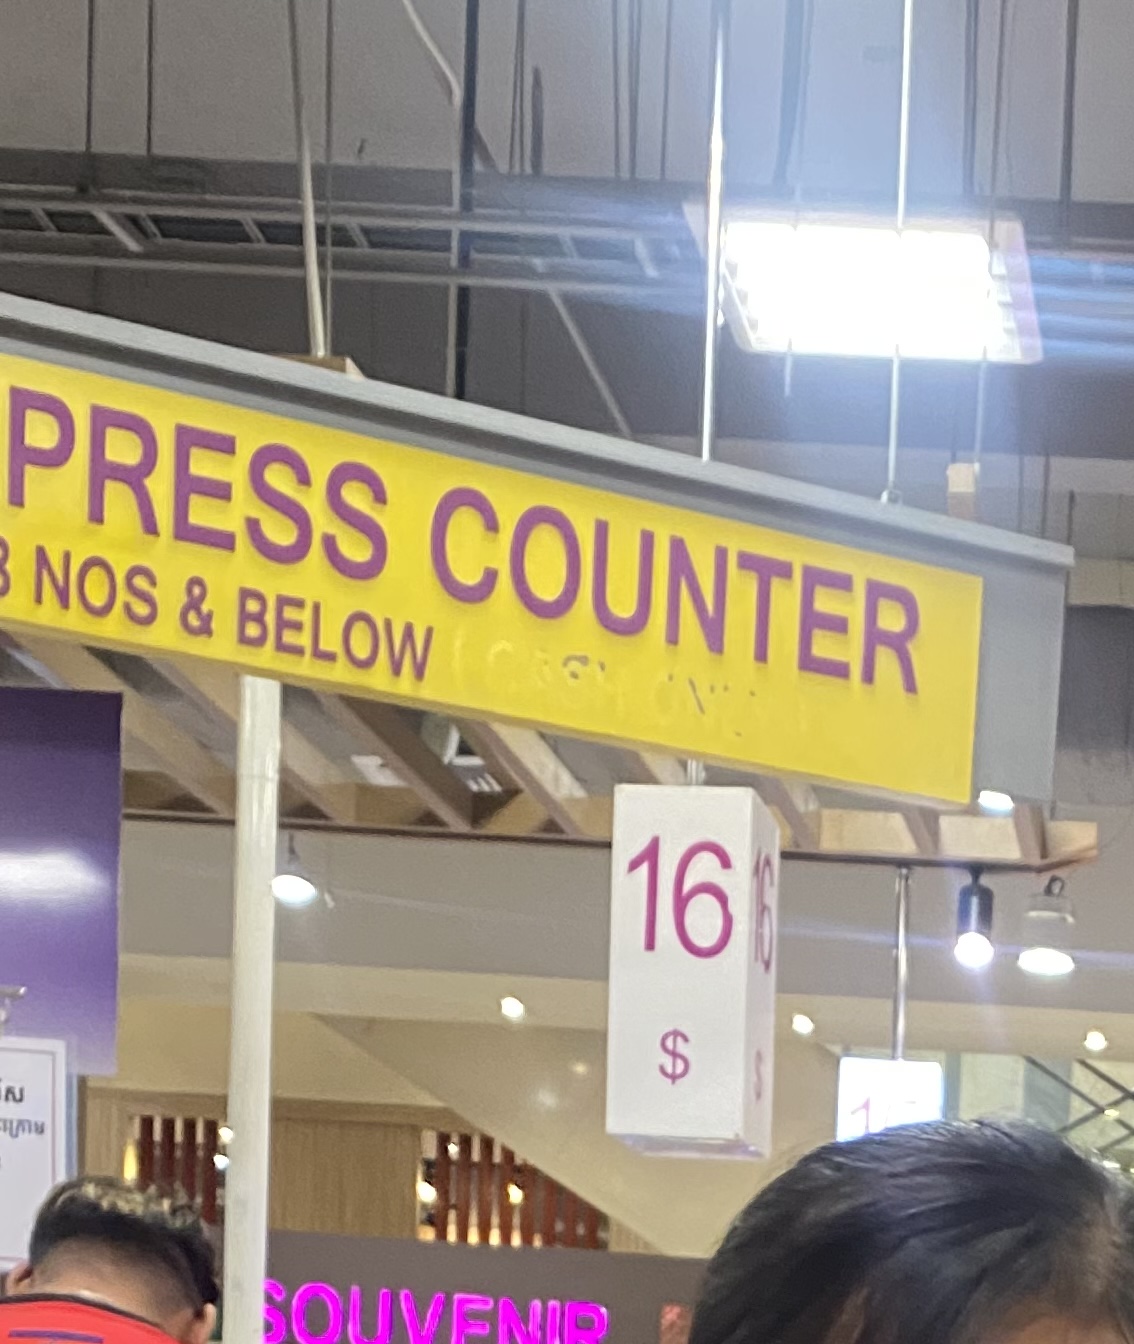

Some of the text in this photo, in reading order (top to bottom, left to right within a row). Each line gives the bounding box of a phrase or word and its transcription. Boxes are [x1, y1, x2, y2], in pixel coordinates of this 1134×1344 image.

[8, 385, 388, 581] PRESS
[431, 487, 919, 695] COUNTER
[35, 544, 158, 626] NOS
[180, 576, 213, 638] &
[238, 587, 433, 682] BELOW
[627, 835, 733, 959] 16
[659, 1029, 690, 1085] $
